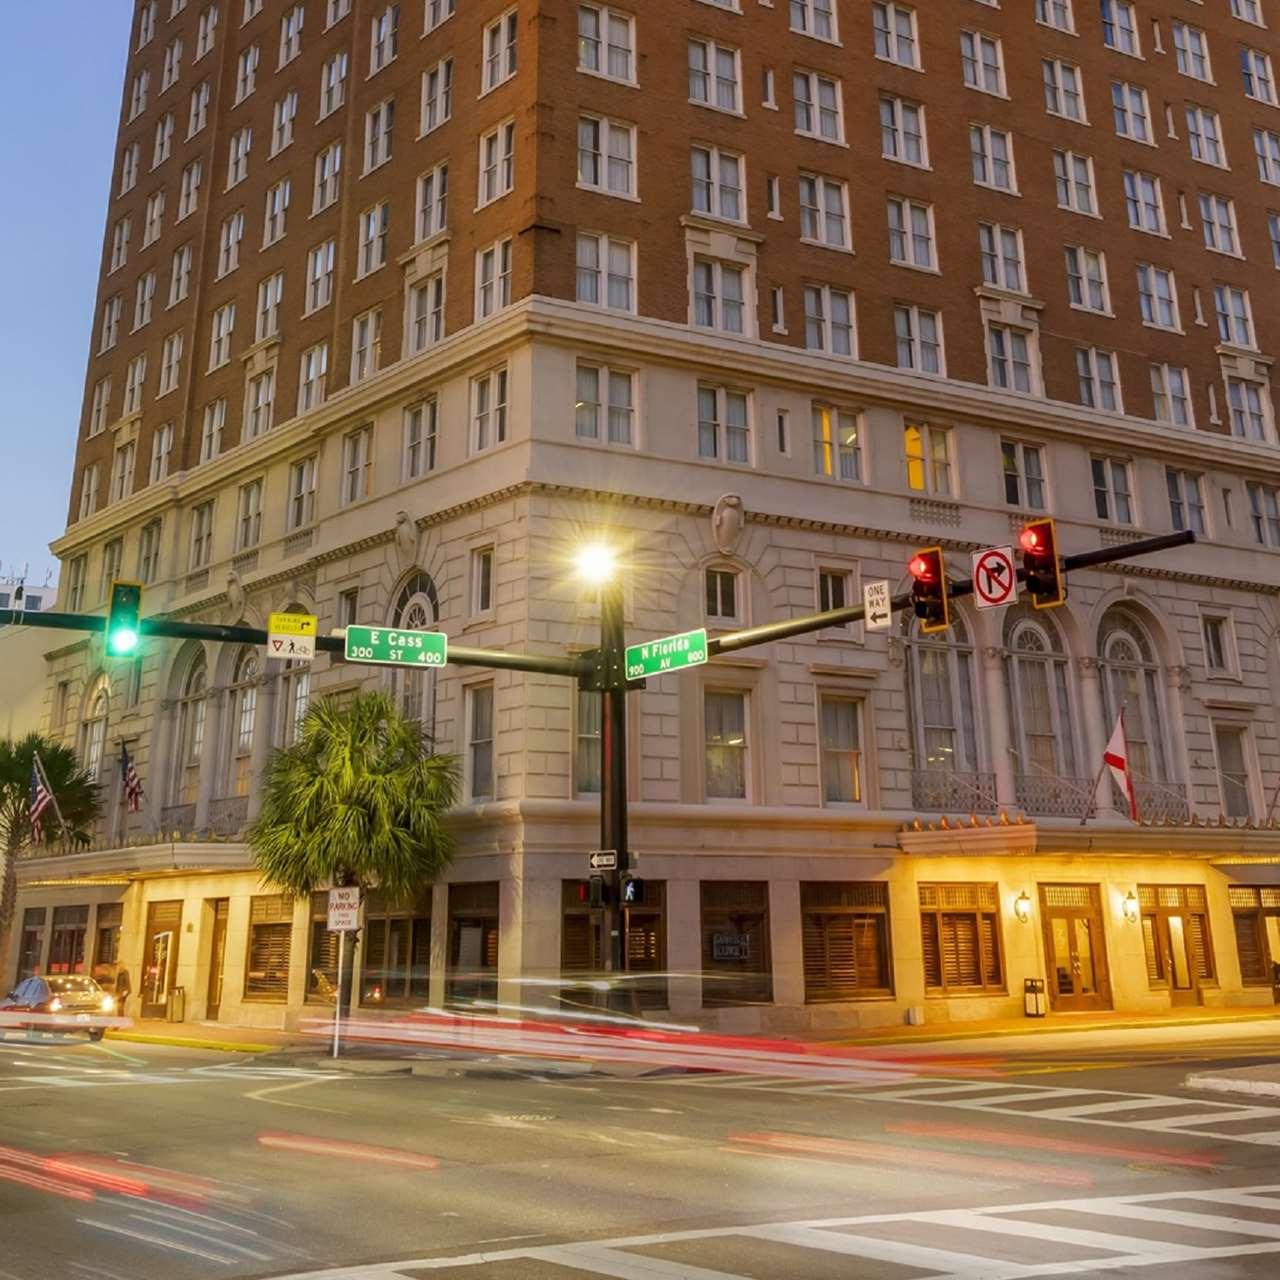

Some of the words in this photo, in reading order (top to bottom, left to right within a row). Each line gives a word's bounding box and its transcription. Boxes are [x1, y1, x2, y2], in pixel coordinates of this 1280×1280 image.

[868, 584, 884, 597] ONE
[868, 596, 886, 608] WAY
[371, 631, 379, 645] E
[388, 632, 423, 647] Cass
[351, 646, 373, 658] 300
[389, 650, 404, 660] ST
[418, 651, 441, 664] 400
[641, 646, 649, 660] N
[652, 638, 689, 657] Florida
[629, 664, 644, 675] 900
[660, 657, 671, 669] AV
[338, 892, 350, 901] NO
[329, 902, 357, 912] PARKING
